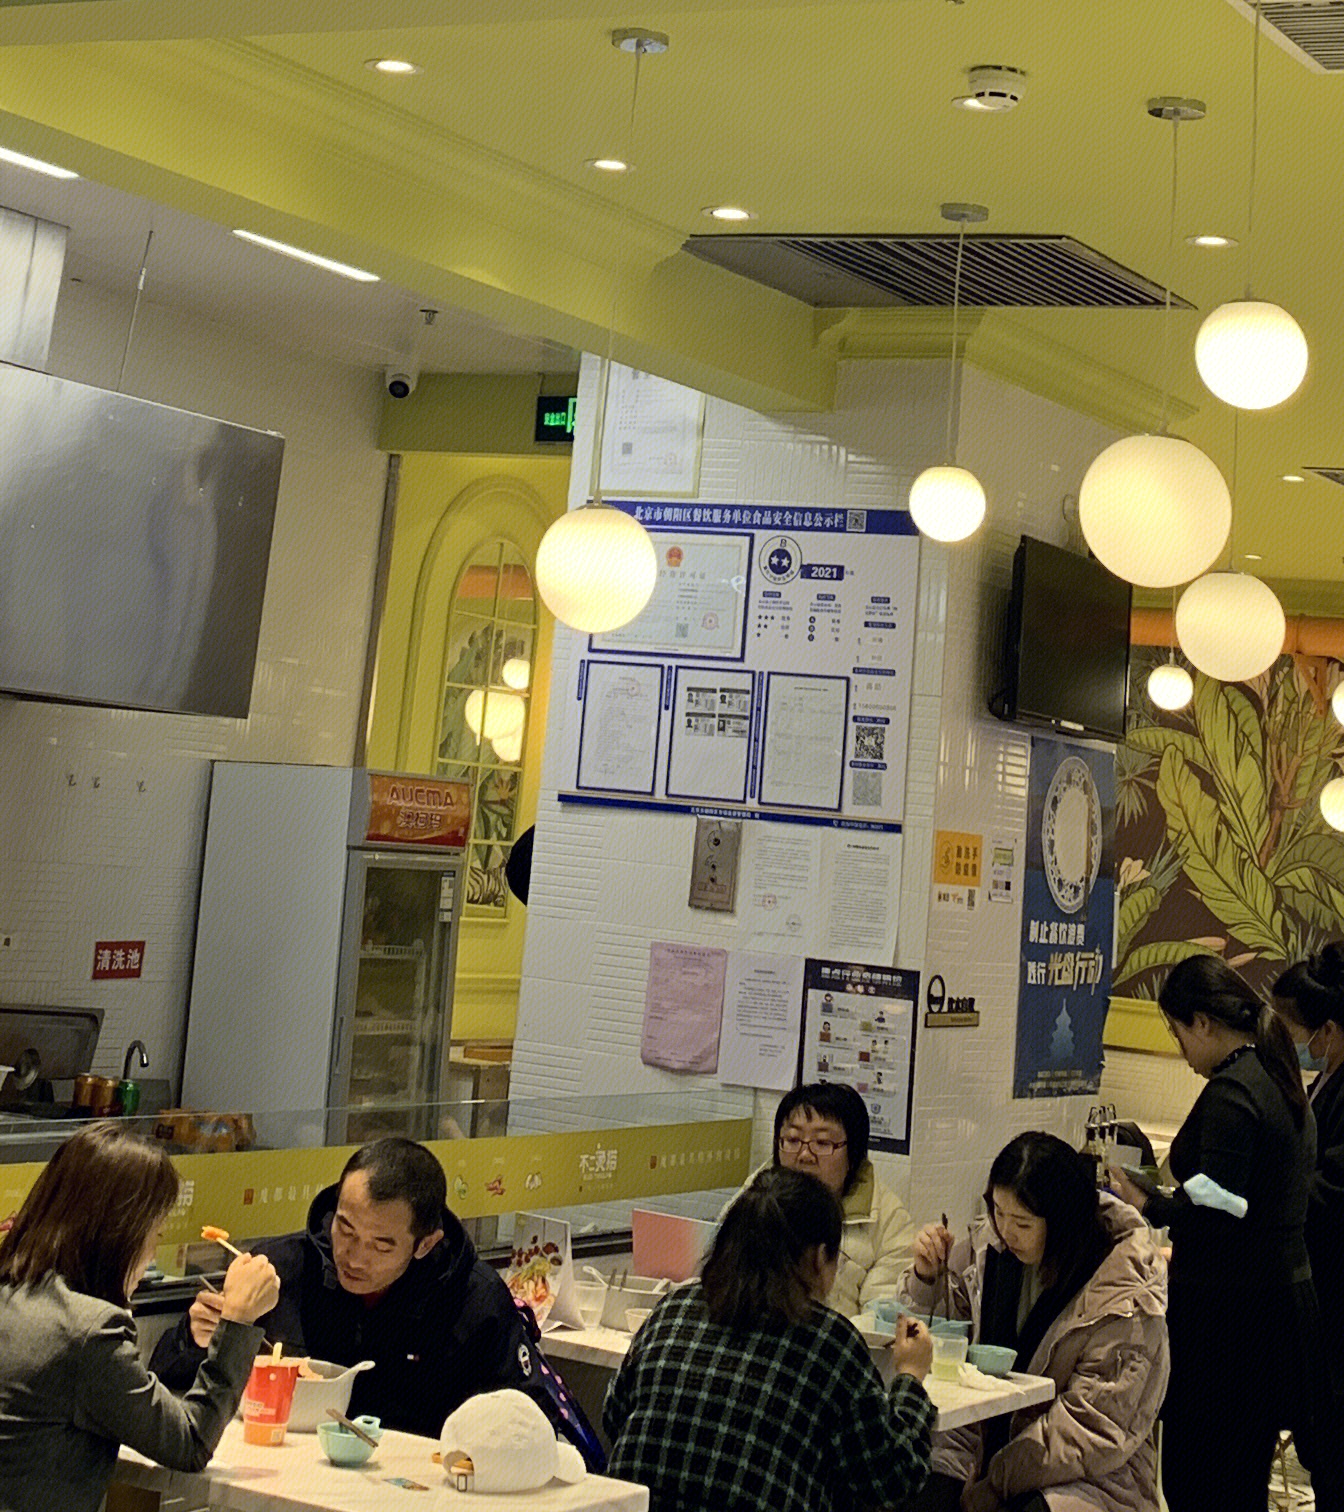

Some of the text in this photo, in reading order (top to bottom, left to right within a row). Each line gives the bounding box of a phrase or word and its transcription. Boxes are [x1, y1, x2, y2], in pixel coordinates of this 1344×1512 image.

[810, 565, 839, 579] 2021
[387, 784, 455, 810] AUCMA
[96, 948, 141, 971] 清洗池
